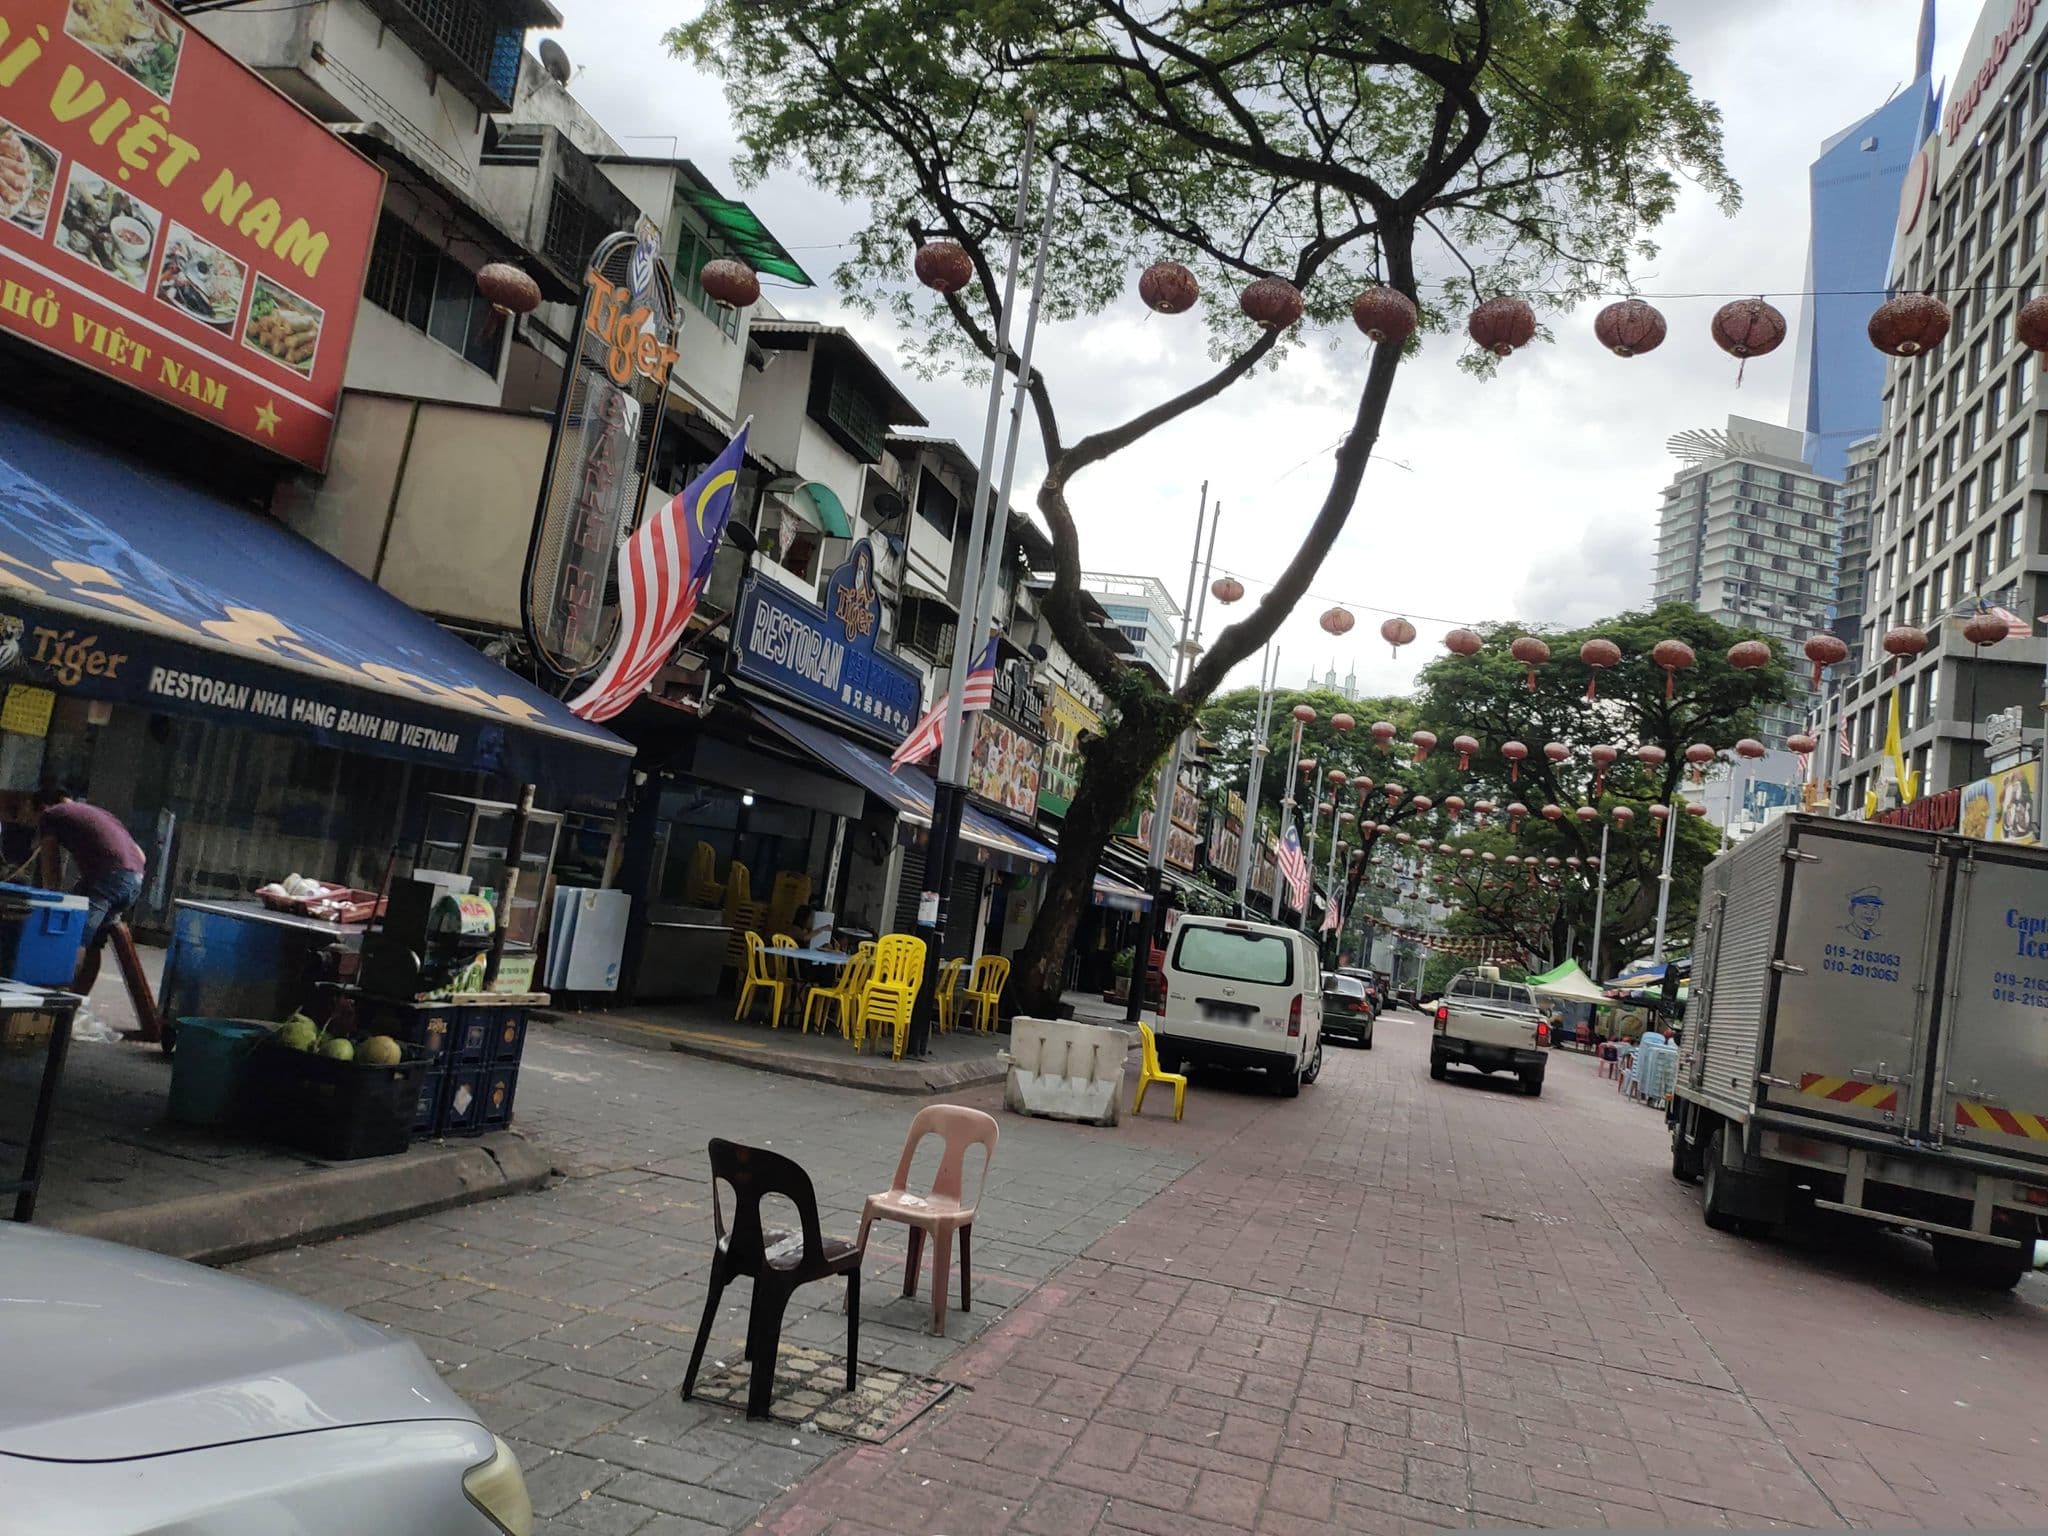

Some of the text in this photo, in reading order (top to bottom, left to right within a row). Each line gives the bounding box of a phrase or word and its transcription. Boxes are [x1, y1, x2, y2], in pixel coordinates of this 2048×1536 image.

[50, 64, 200, 187] VIỆT
[202, 168, 330, 278] NAM
[0, 279, 228, 410] HỞ VIỆT NAM
[584, 266, 680, 387] Tiger
[31, 626, 128, 686] Tiger
[750, 599, 845, 692] RESTORAN
[835, 584, 875, 642] Tiger
[150, 666, 459, 754] RESTORAN NHA HANG BANH MI VIETNAM
[1825, 943, 1901, 967] 019-2163063
[2016, 930, 2048, 960] Ice
